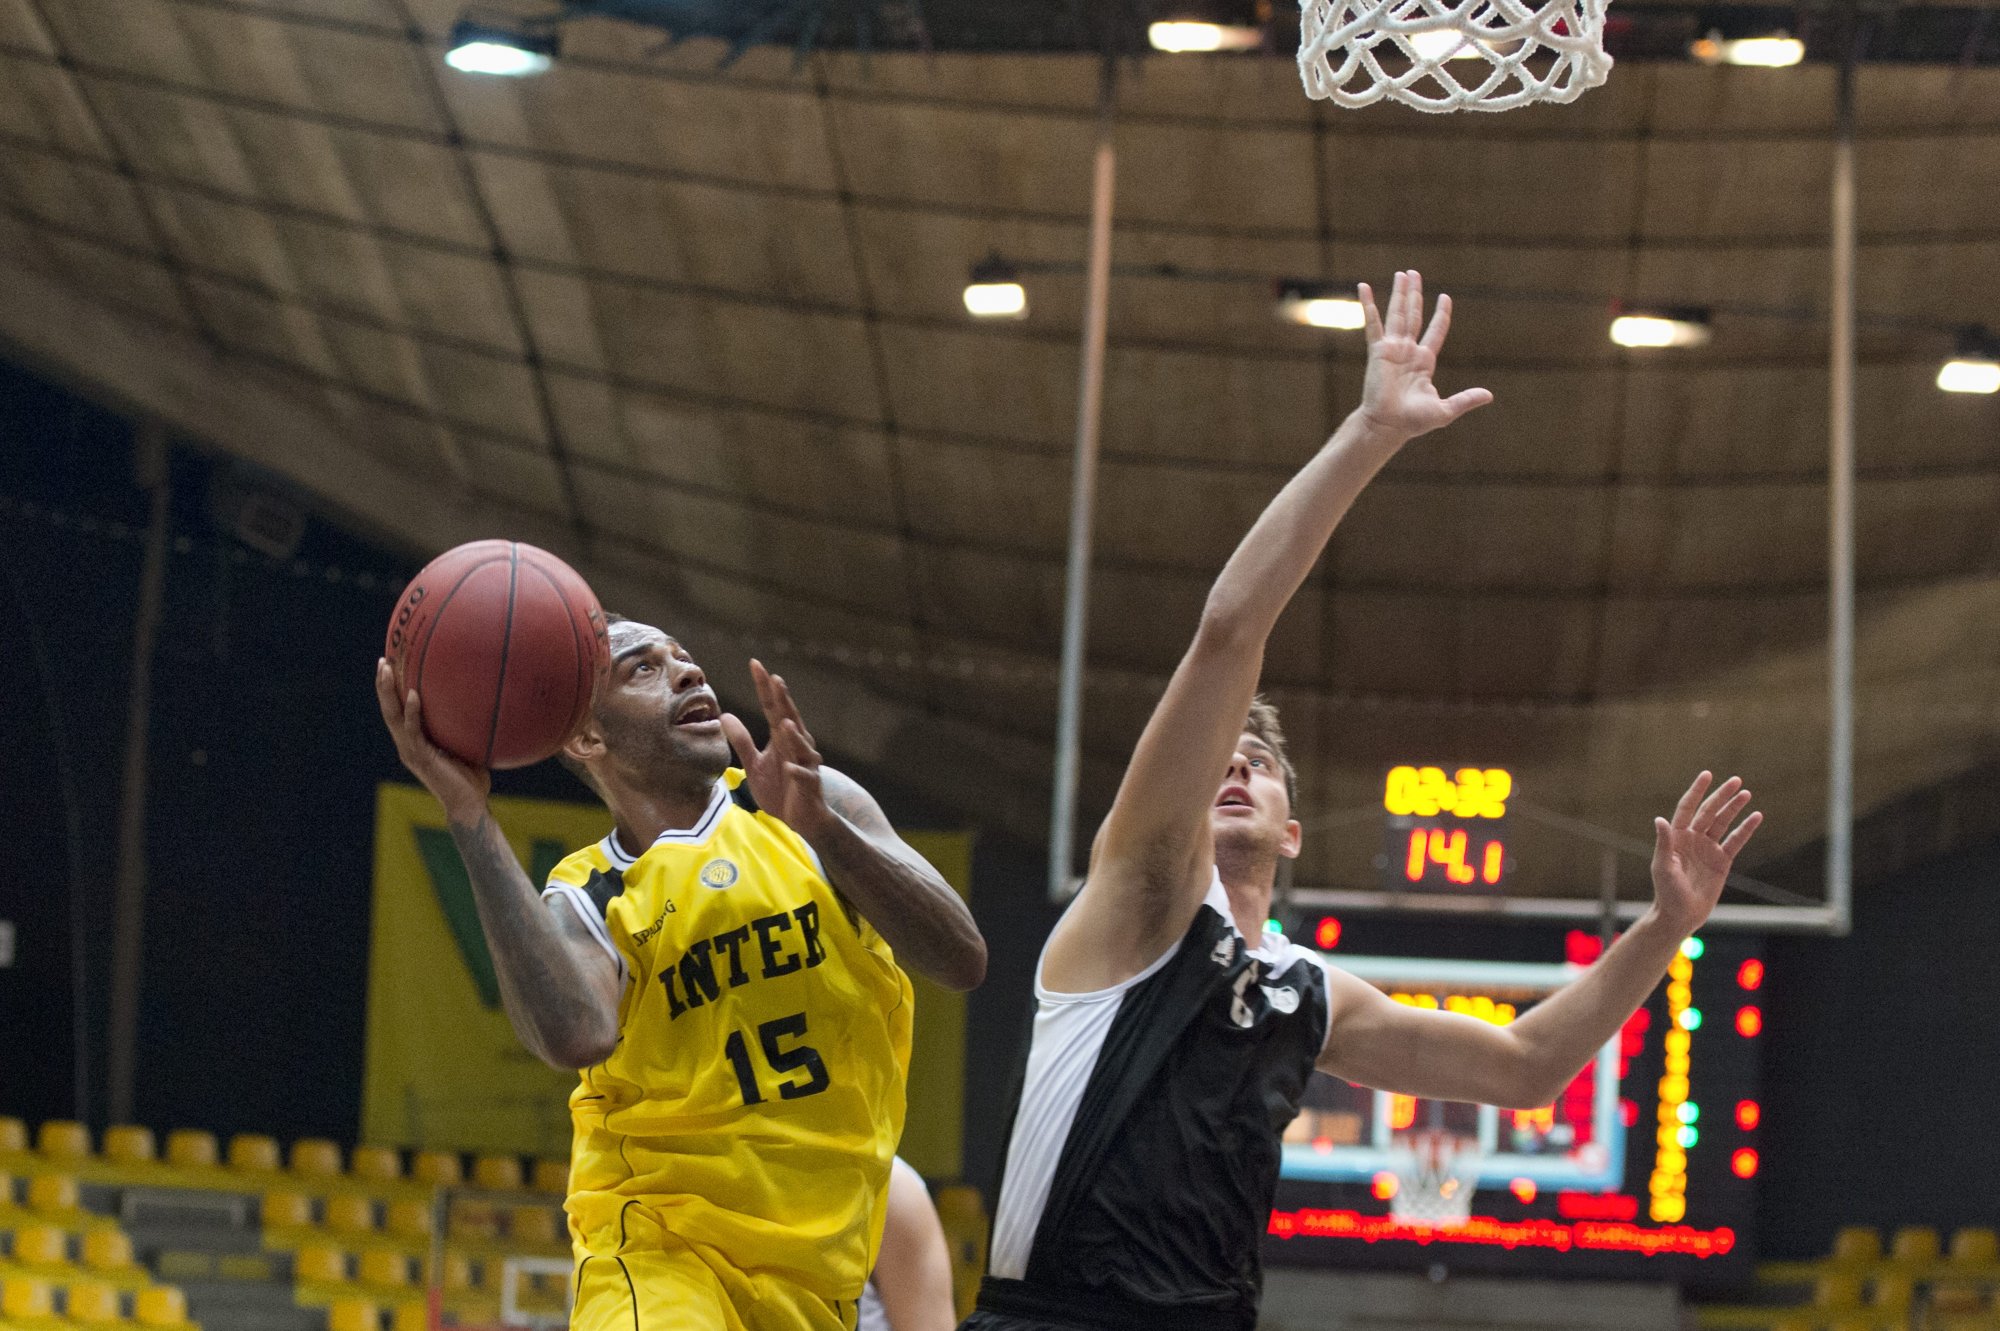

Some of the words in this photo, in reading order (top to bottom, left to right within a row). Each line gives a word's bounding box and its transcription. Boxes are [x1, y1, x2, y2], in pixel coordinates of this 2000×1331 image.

[633, 899, 676, 947] SPALDG
[658, 901, 826, 1021] INTER
[725, 1012, 830, 1105] 15
